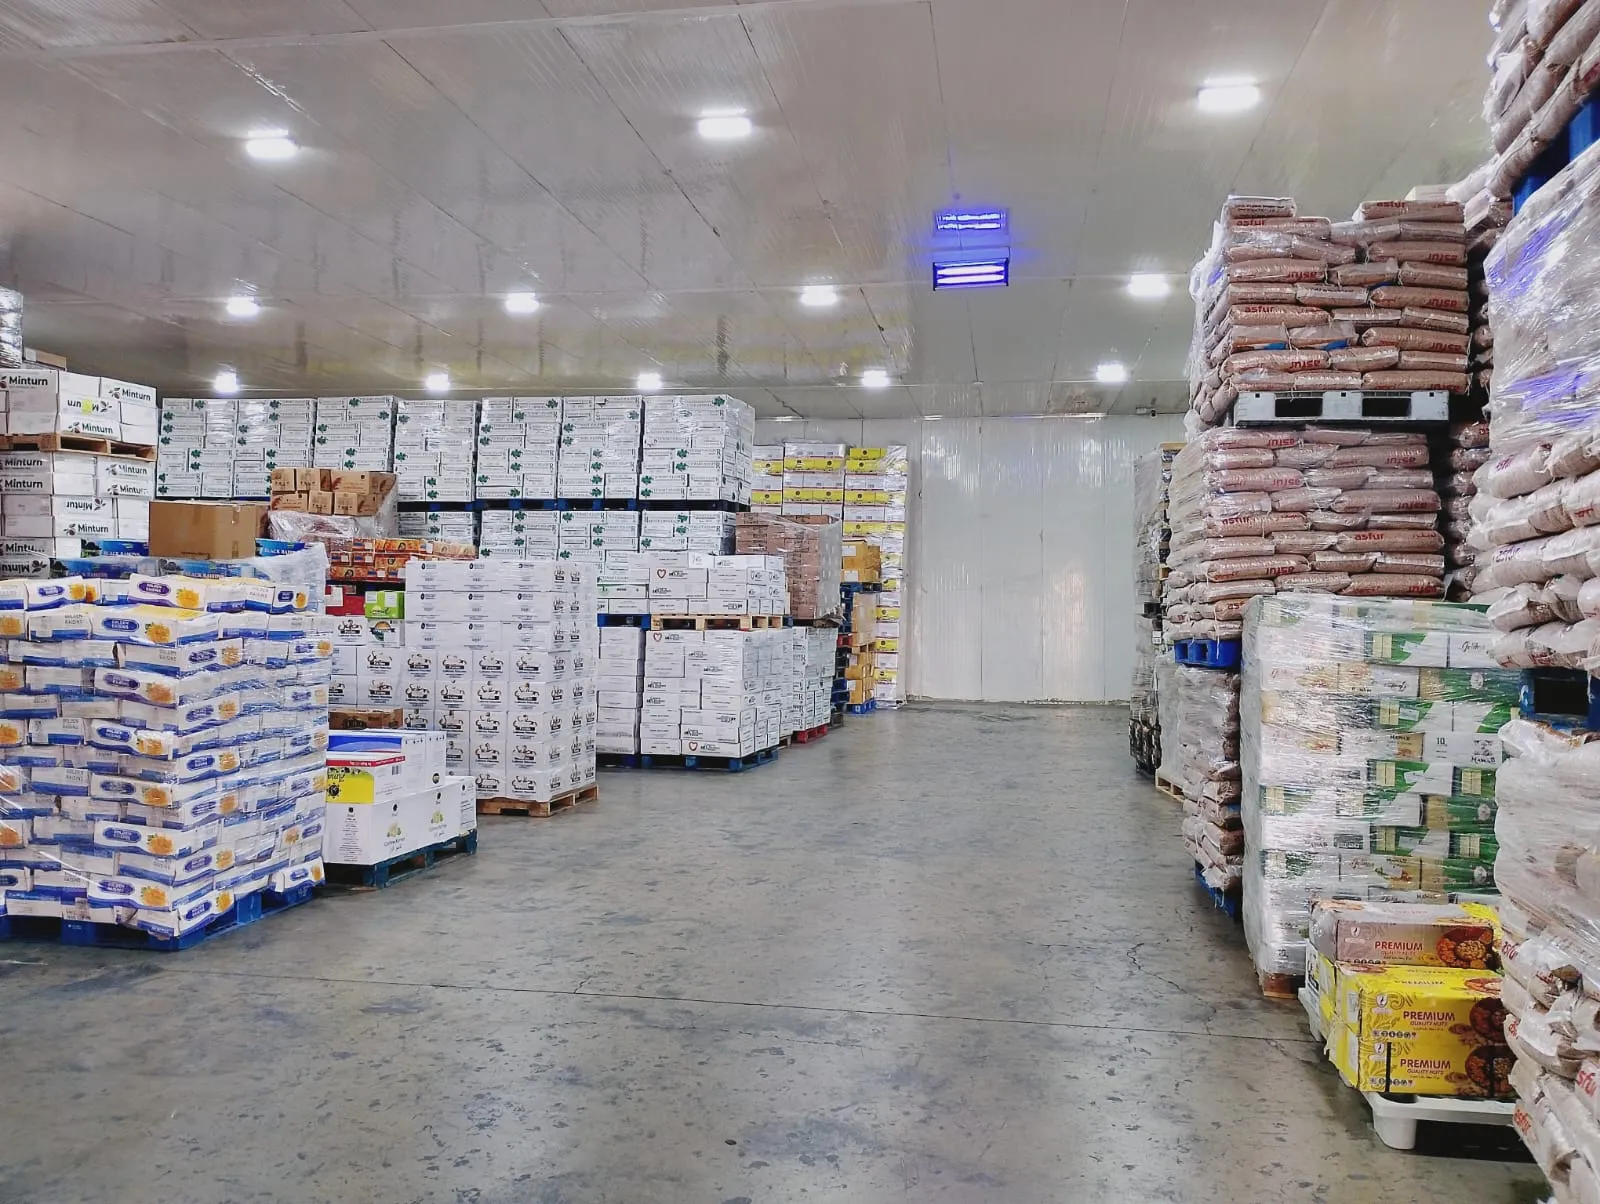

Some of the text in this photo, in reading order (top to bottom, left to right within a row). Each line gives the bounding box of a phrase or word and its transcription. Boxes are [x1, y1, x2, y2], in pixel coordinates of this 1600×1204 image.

[1429, 253, 1457, 261] asfur
[1429, 298, 1458, 308] asfur
[1245, 305, 1274, 313] asfur
[1291, 359, 1320, 370] asfur
[9, 376, 48, 386] Minturn
[122, 388, 151, 401] Minturn
[82, 423, 113, 435] Minturn
[1268, 438, 1297, 448] asfur
[5, 457, 43, 467] Minturn
[1385, 456, 1416, 465] asfur
[4, 478, 43, 489] Minturn
[1272, 478, 1301, 488] asfur
[78, 524, 109, 534] Minturn
[1355, 532, 1384, 541] asfur
[1266, 566, 1294, 576] asfur
[1375, 940, 1423, 951] PREMIUM
[1403, 1011, 1455, 1021] PREMIUM
[1400, 1058, 1451, 1069] PREMIUM
